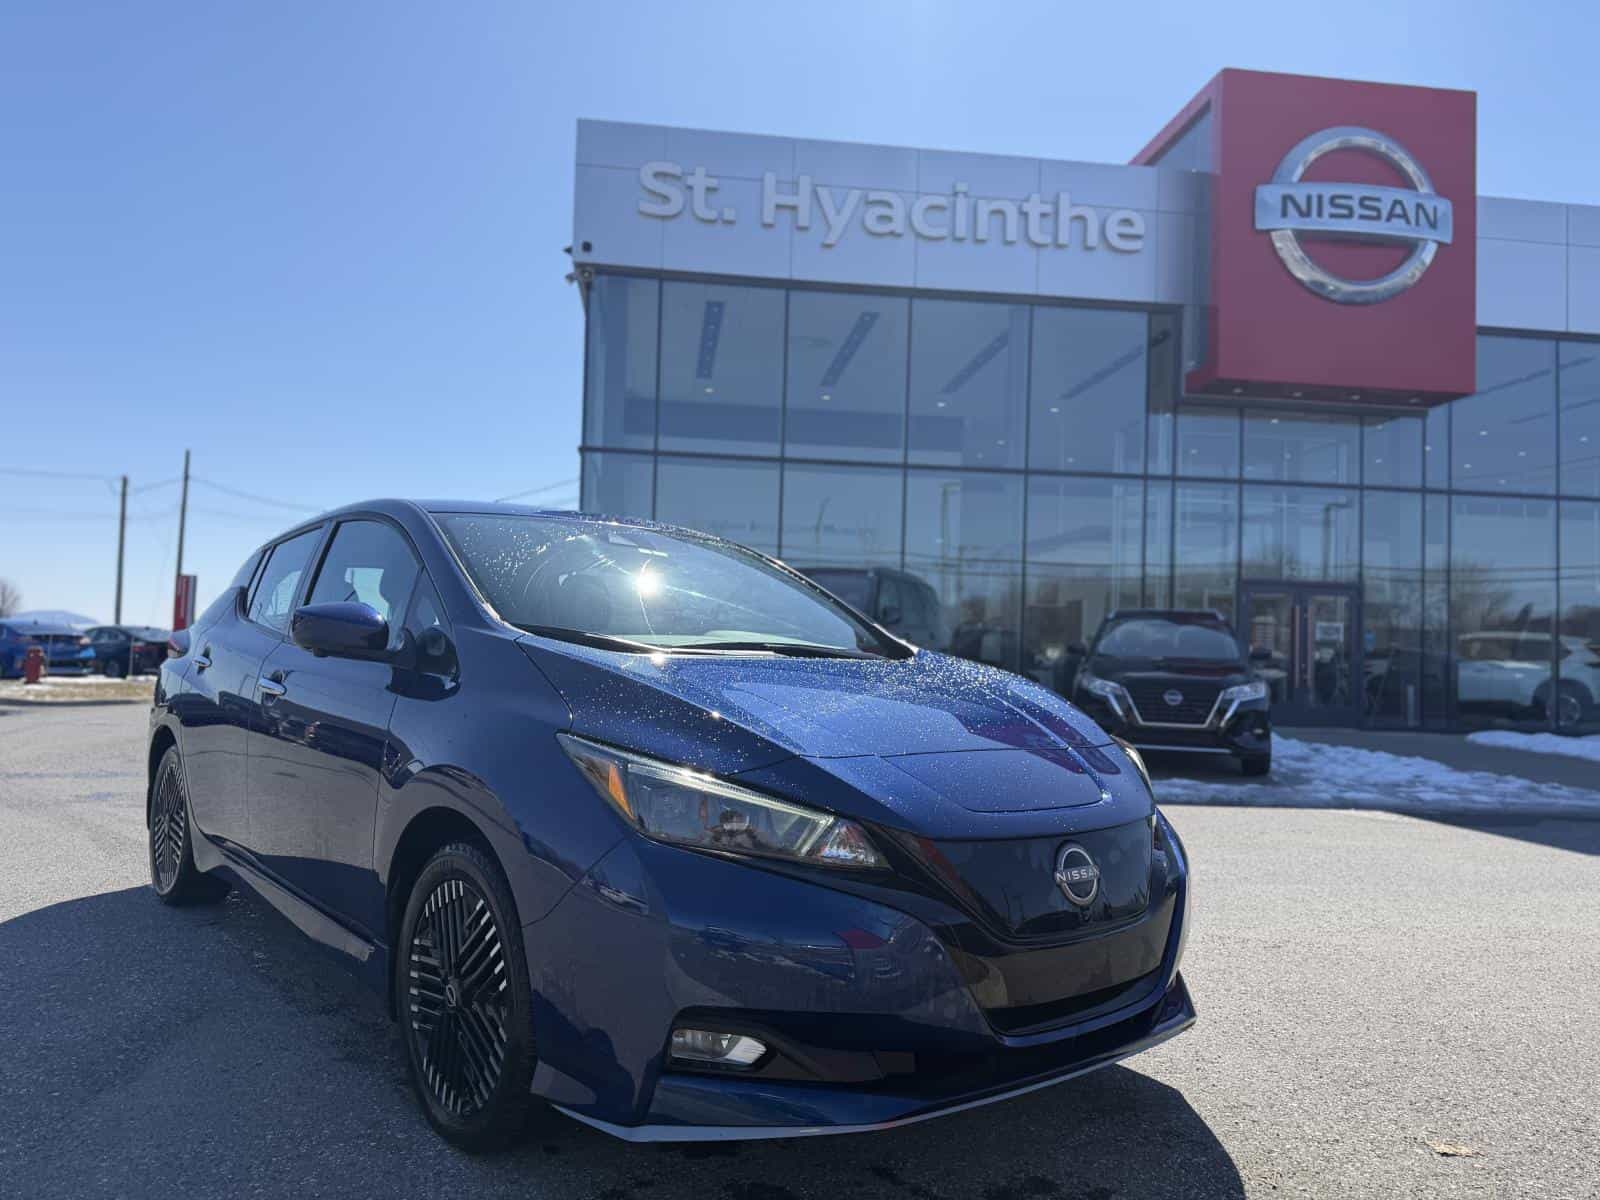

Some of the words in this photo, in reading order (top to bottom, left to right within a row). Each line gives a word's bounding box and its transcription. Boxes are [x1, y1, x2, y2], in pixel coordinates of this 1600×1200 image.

[638, 161, 737, 224] St.
[760, 170, 1146, 252] Hyacinthe
[1280, 193, 1438, 230] NISSAN
